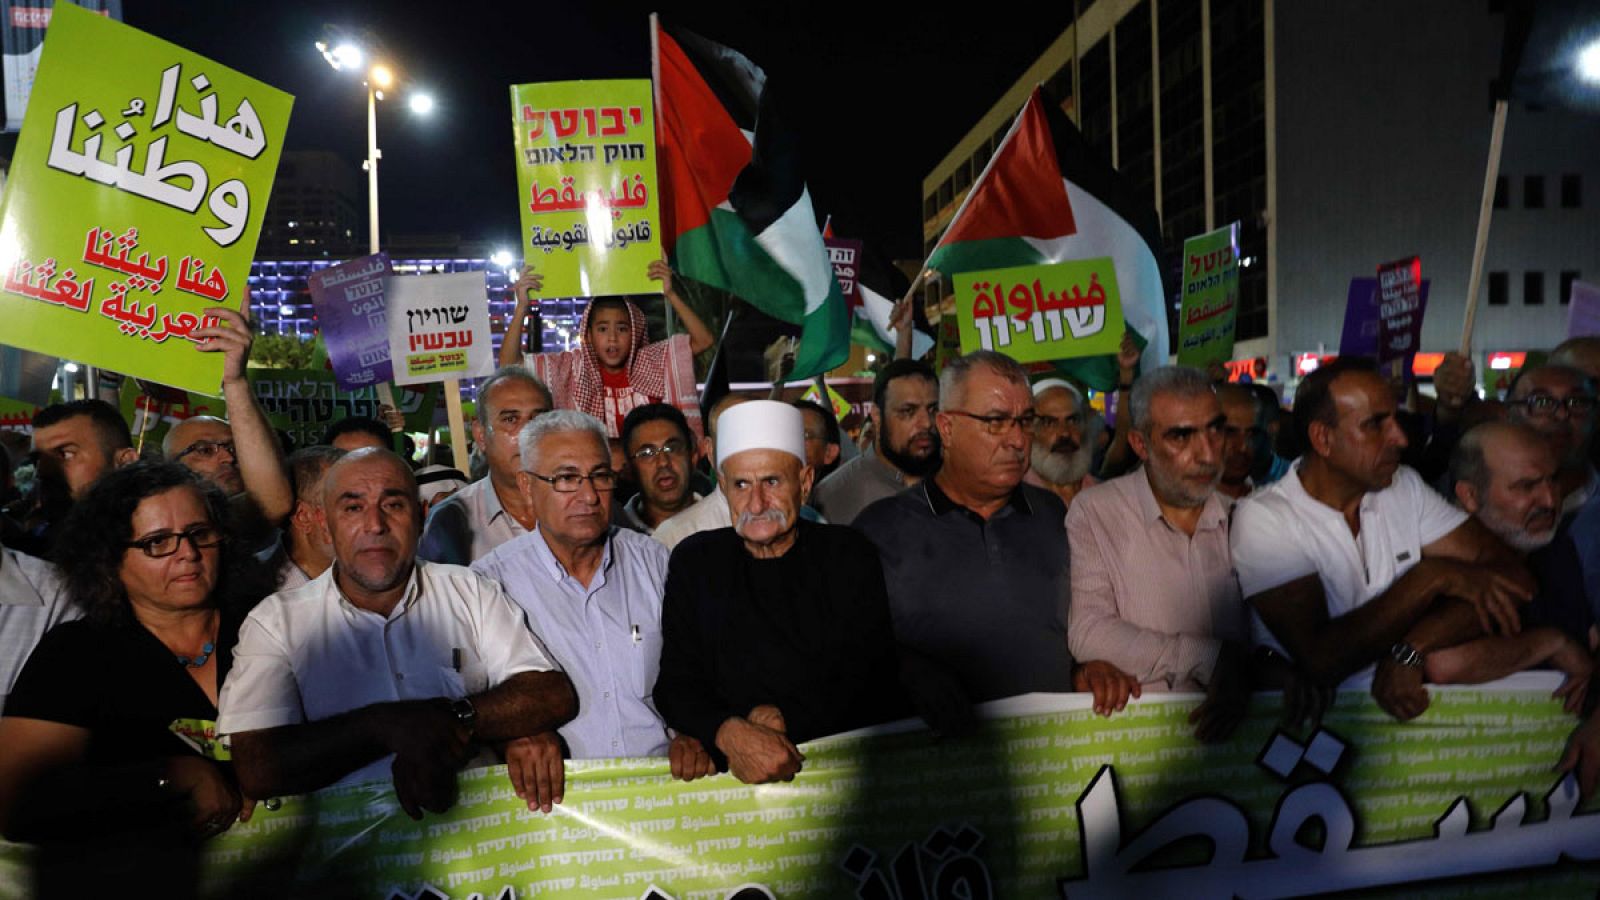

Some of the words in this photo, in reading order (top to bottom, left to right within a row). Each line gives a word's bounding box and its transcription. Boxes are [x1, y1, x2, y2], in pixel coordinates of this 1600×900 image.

[151, 62, 267, 160] هذا
[523, 104, 643, 141] יבוטל
[525, 143, 595, 165] הלאום
[603, 143, 645, 164] חוק
[175, 255, 229, 301] هنا
[406, 304, 470, 333] שוויון
[975, 303, 1106, 352] שוויון
[408, 329, 473, 352] עכשיו
